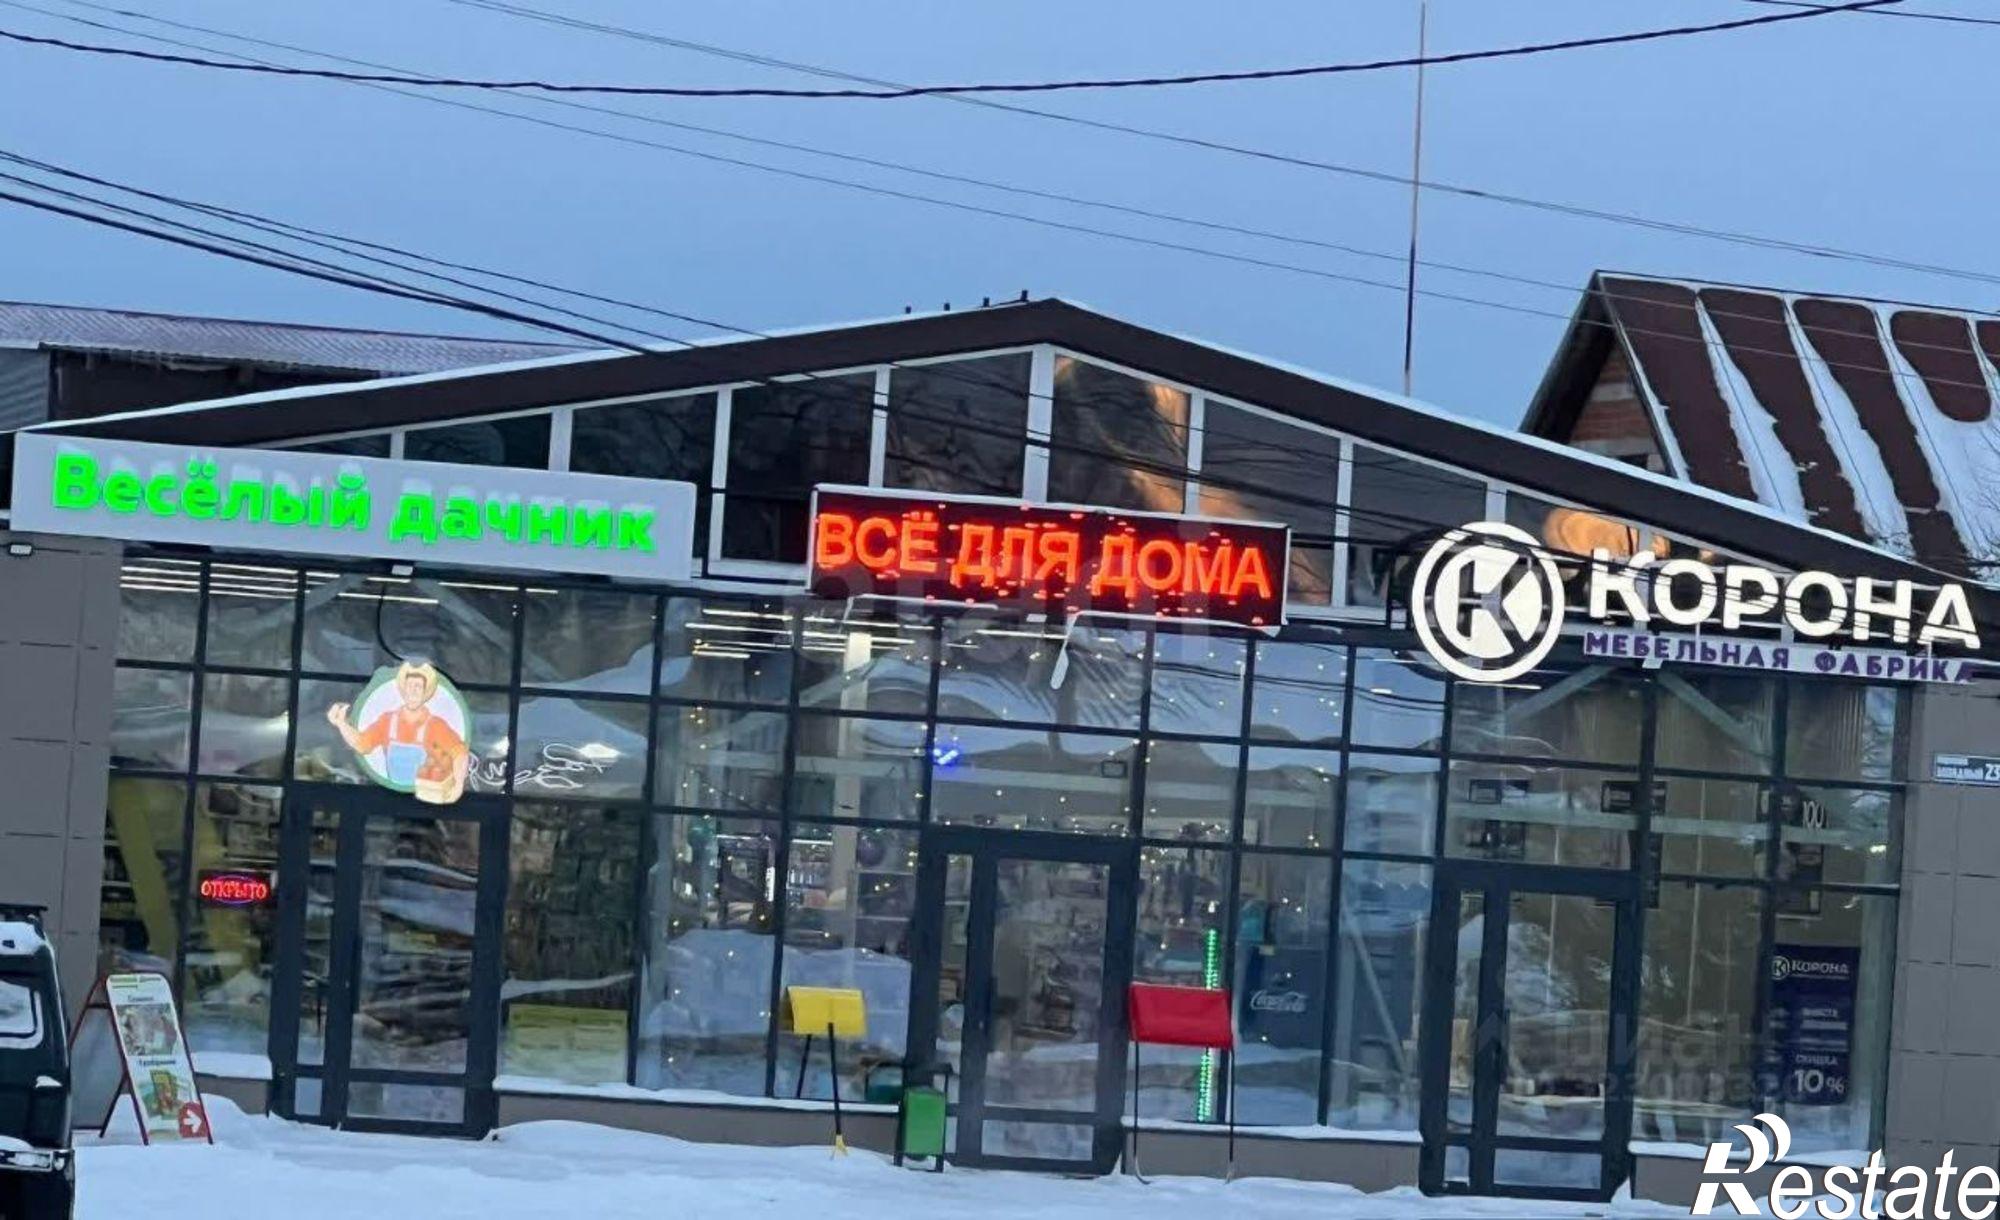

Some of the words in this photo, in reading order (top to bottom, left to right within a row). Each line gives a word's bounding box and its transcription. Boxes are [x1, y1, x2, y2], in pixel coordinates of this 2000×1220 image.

[54, 453, 371, 531] Весёлый
[389, 490, 657, 552] дачник
[817, 511, 938, 573] ВСЁ
[950, 523, 1079, 588] ДЛЯ
[1091, 534, 1271, 599] ДОМА
[1590, 548, 1981, 649] КОРОНА
[1585, 631, 1790, 670] МЕБЕЛЬНАЯ
[1814, 650, 1976, 683] ФАБРИКА
[201, 880, 267, 900] ОТКРЫТО
[1791, 960, 1849, 974] КОРОНА
